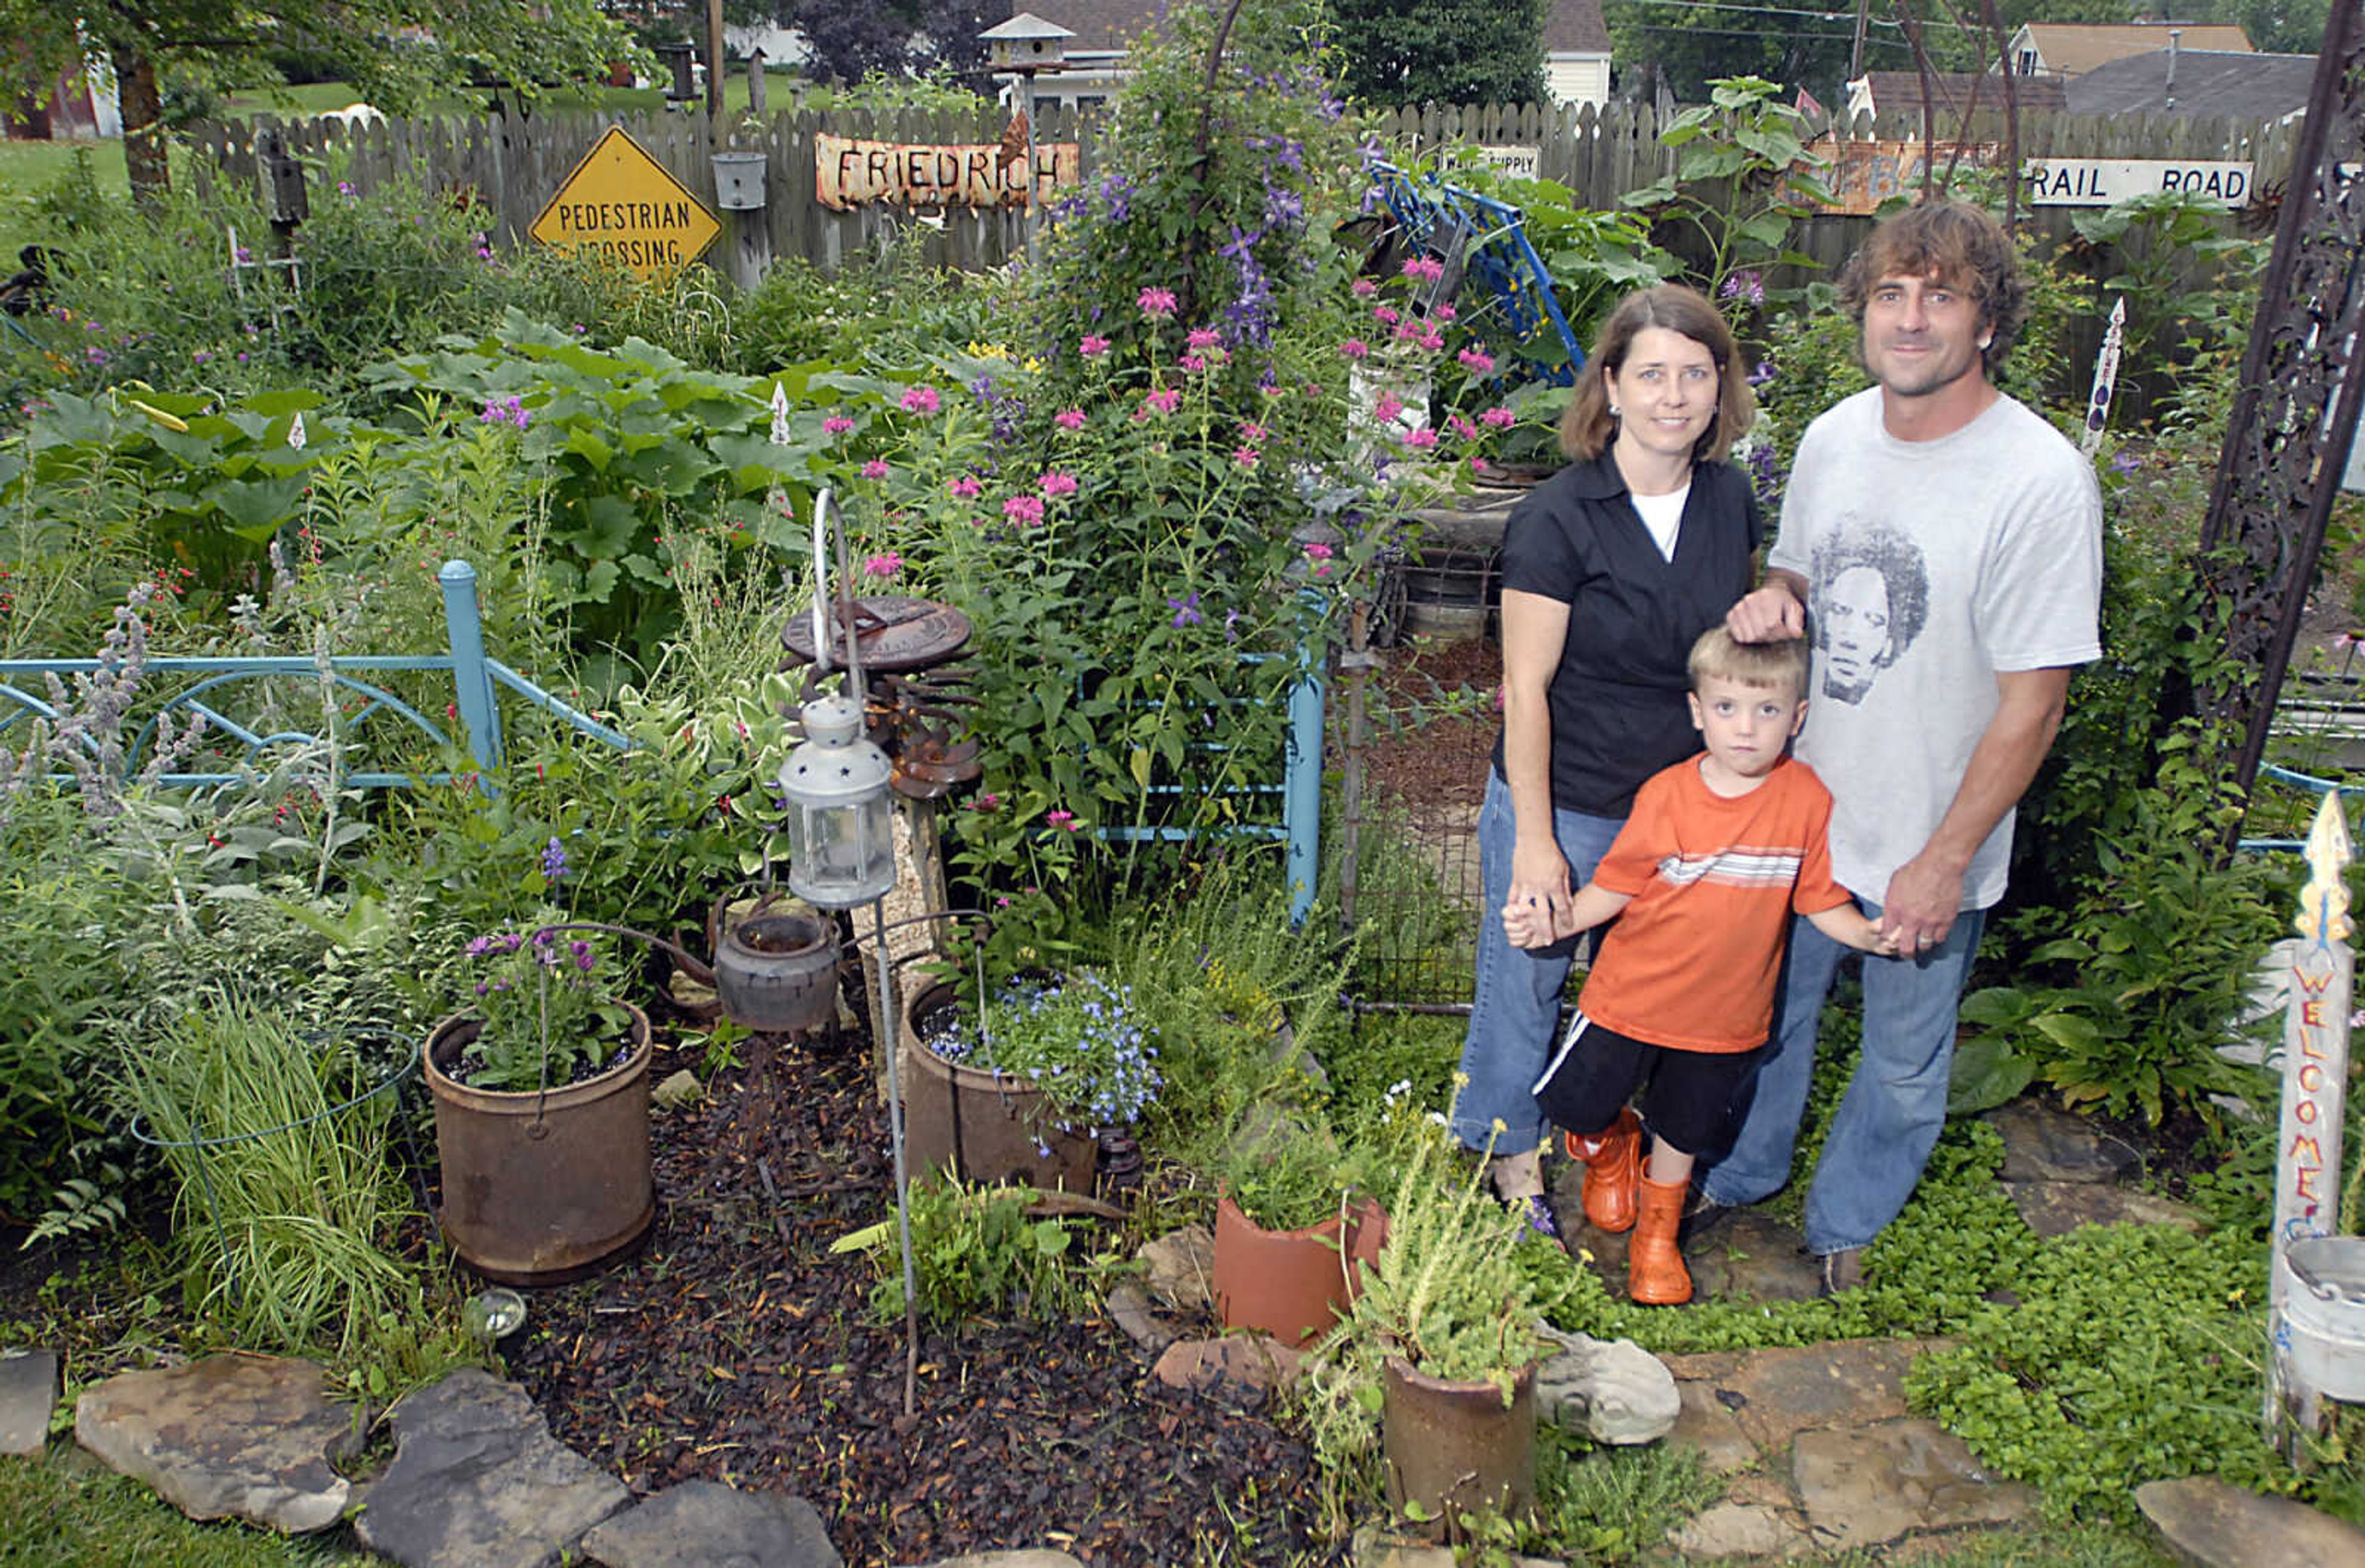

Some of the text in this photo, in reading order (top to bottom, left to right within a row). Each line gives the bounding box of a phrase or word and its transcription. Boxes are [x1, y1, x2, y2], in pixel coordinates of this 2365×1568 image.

[839, 150, 1059, 192] FRIEDRICH
[2033, 168, 2246, 199] RAIL ROAD
[559, 202, 690, 231] PEDESTRIAN
[578, 240, 681, 266] ROSSING
[2289, 965, 2336, 1203] WELCOME
